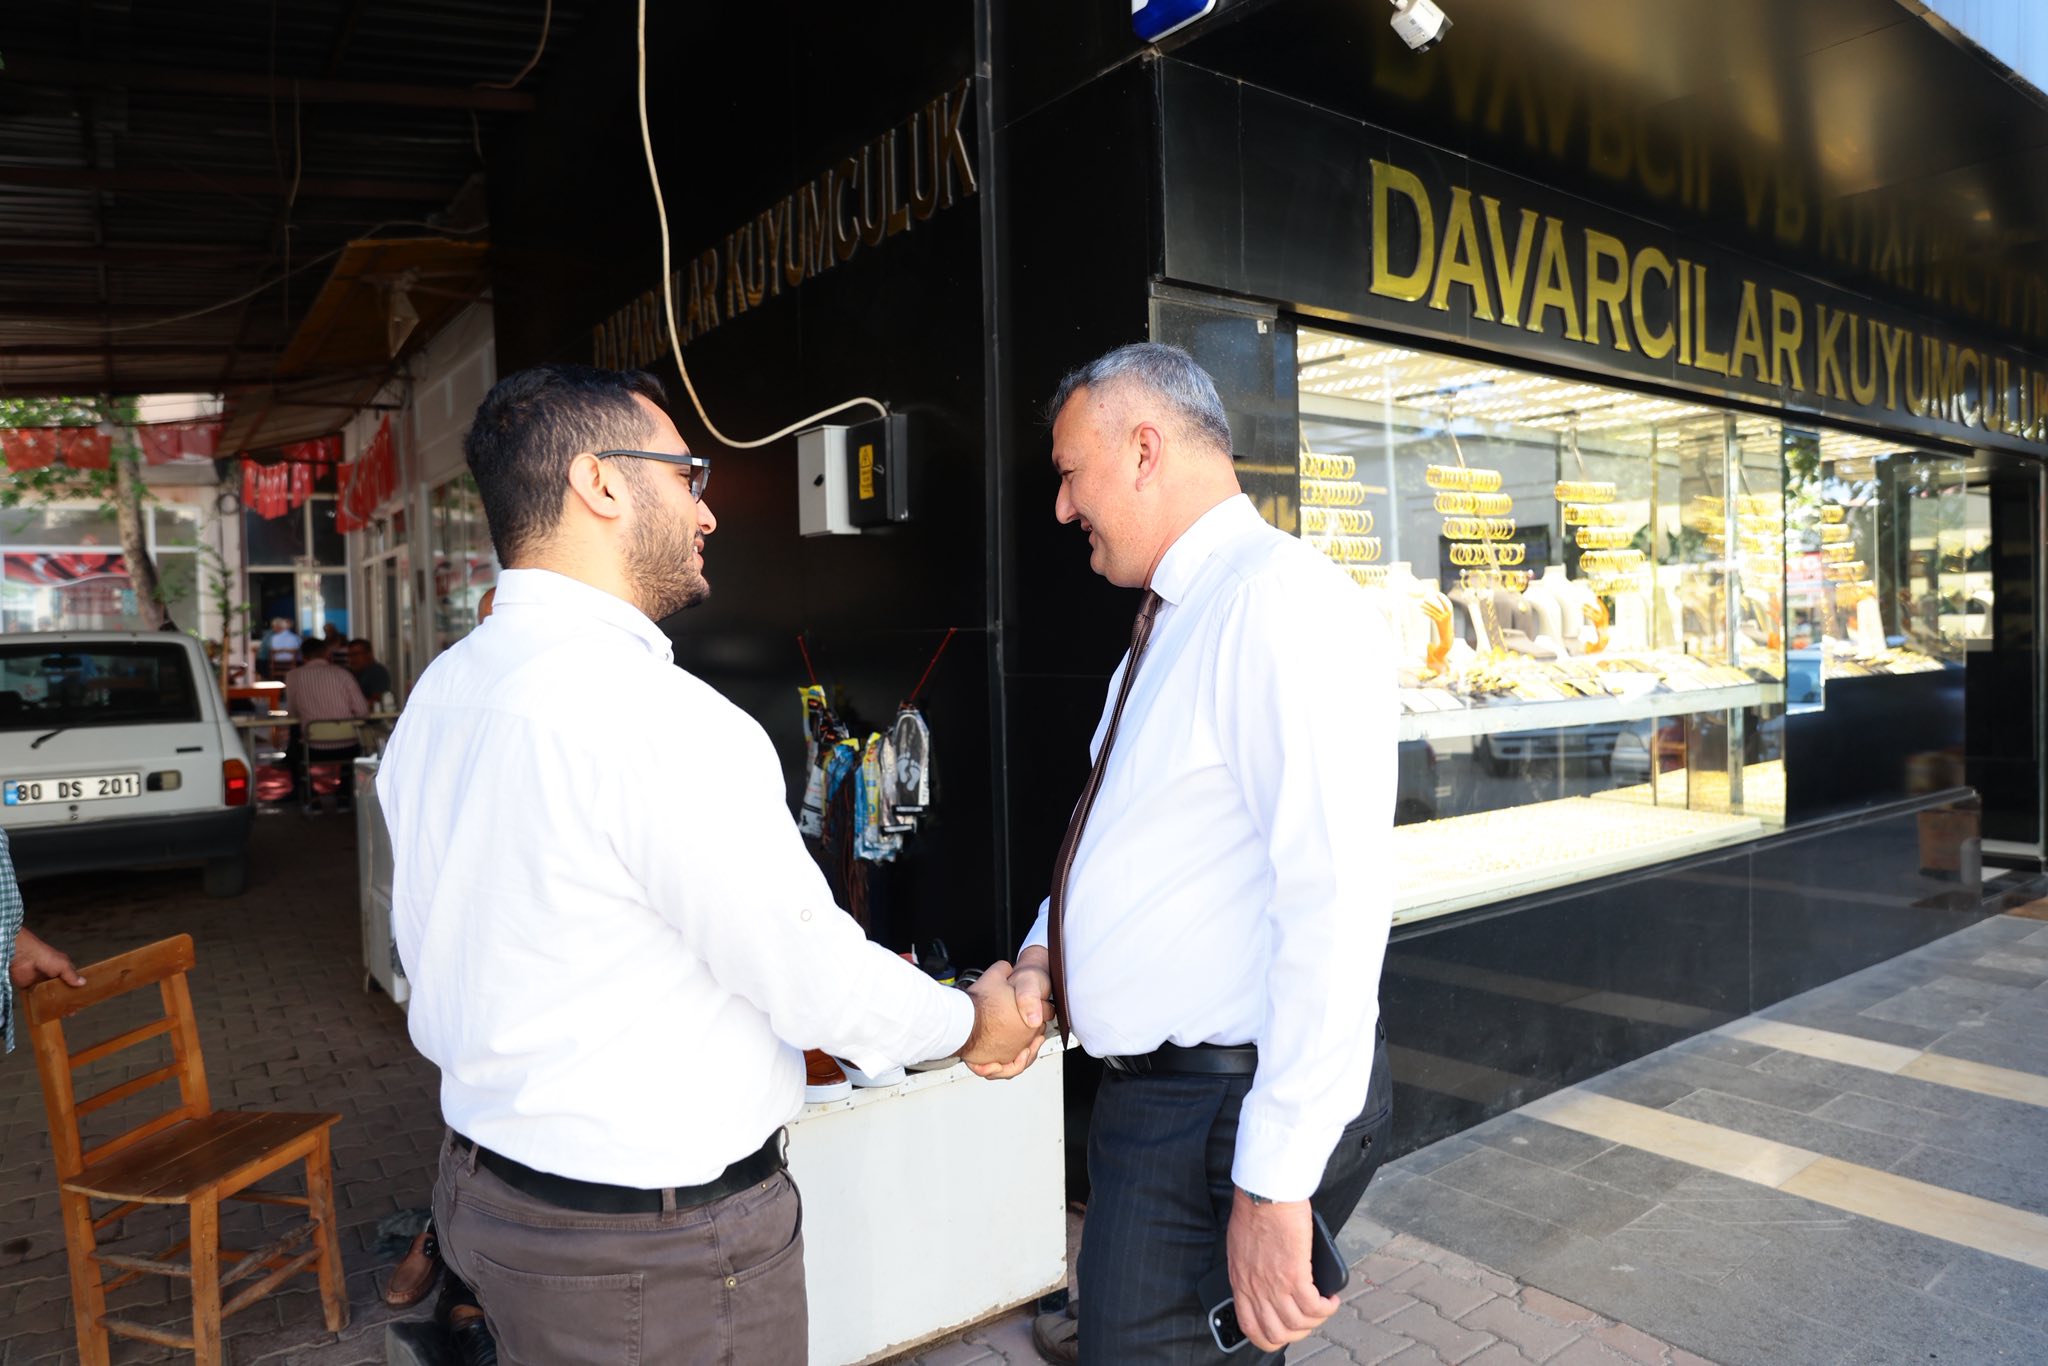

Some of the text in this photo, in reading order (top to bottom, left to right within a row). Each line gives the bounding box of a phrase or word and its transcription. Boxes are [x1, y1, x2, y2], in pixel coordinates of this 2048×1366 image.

[592, 78, 977, 370] DAVARCLAR KUYUMCULUK
[1369, 159, 1802, 391] DAVARCILAR
[16, 784, 41, 801] 80
[58, 781, 82, 798] DS
[98, 777, 133, 795] 201
